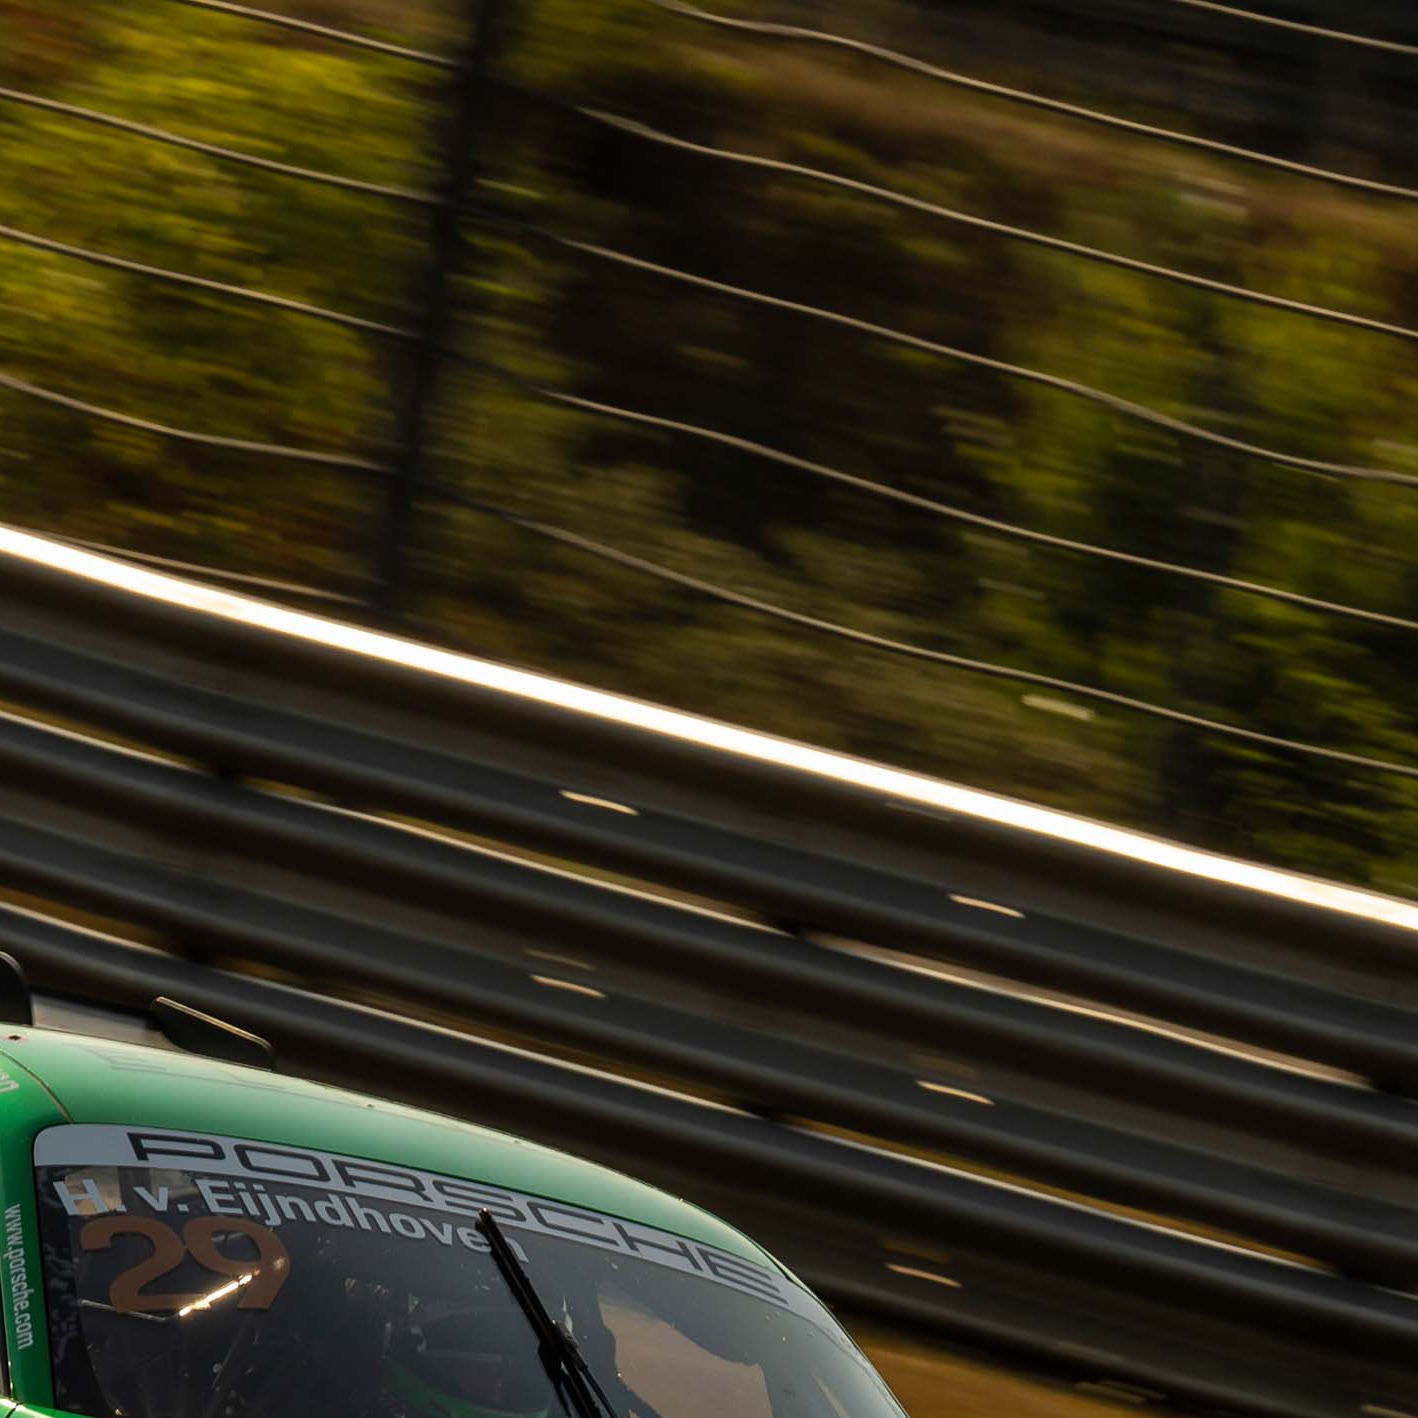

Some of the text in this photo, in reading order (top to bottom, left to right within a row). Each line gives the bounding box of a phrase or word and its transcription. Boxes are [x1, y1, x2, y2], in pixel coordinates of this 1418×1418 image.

[3, 1203, 35, 1350] www.porsche.com
[82, 1214, 291, 1314] 29
[126, 1131, 788, 1304] PORSCHE
